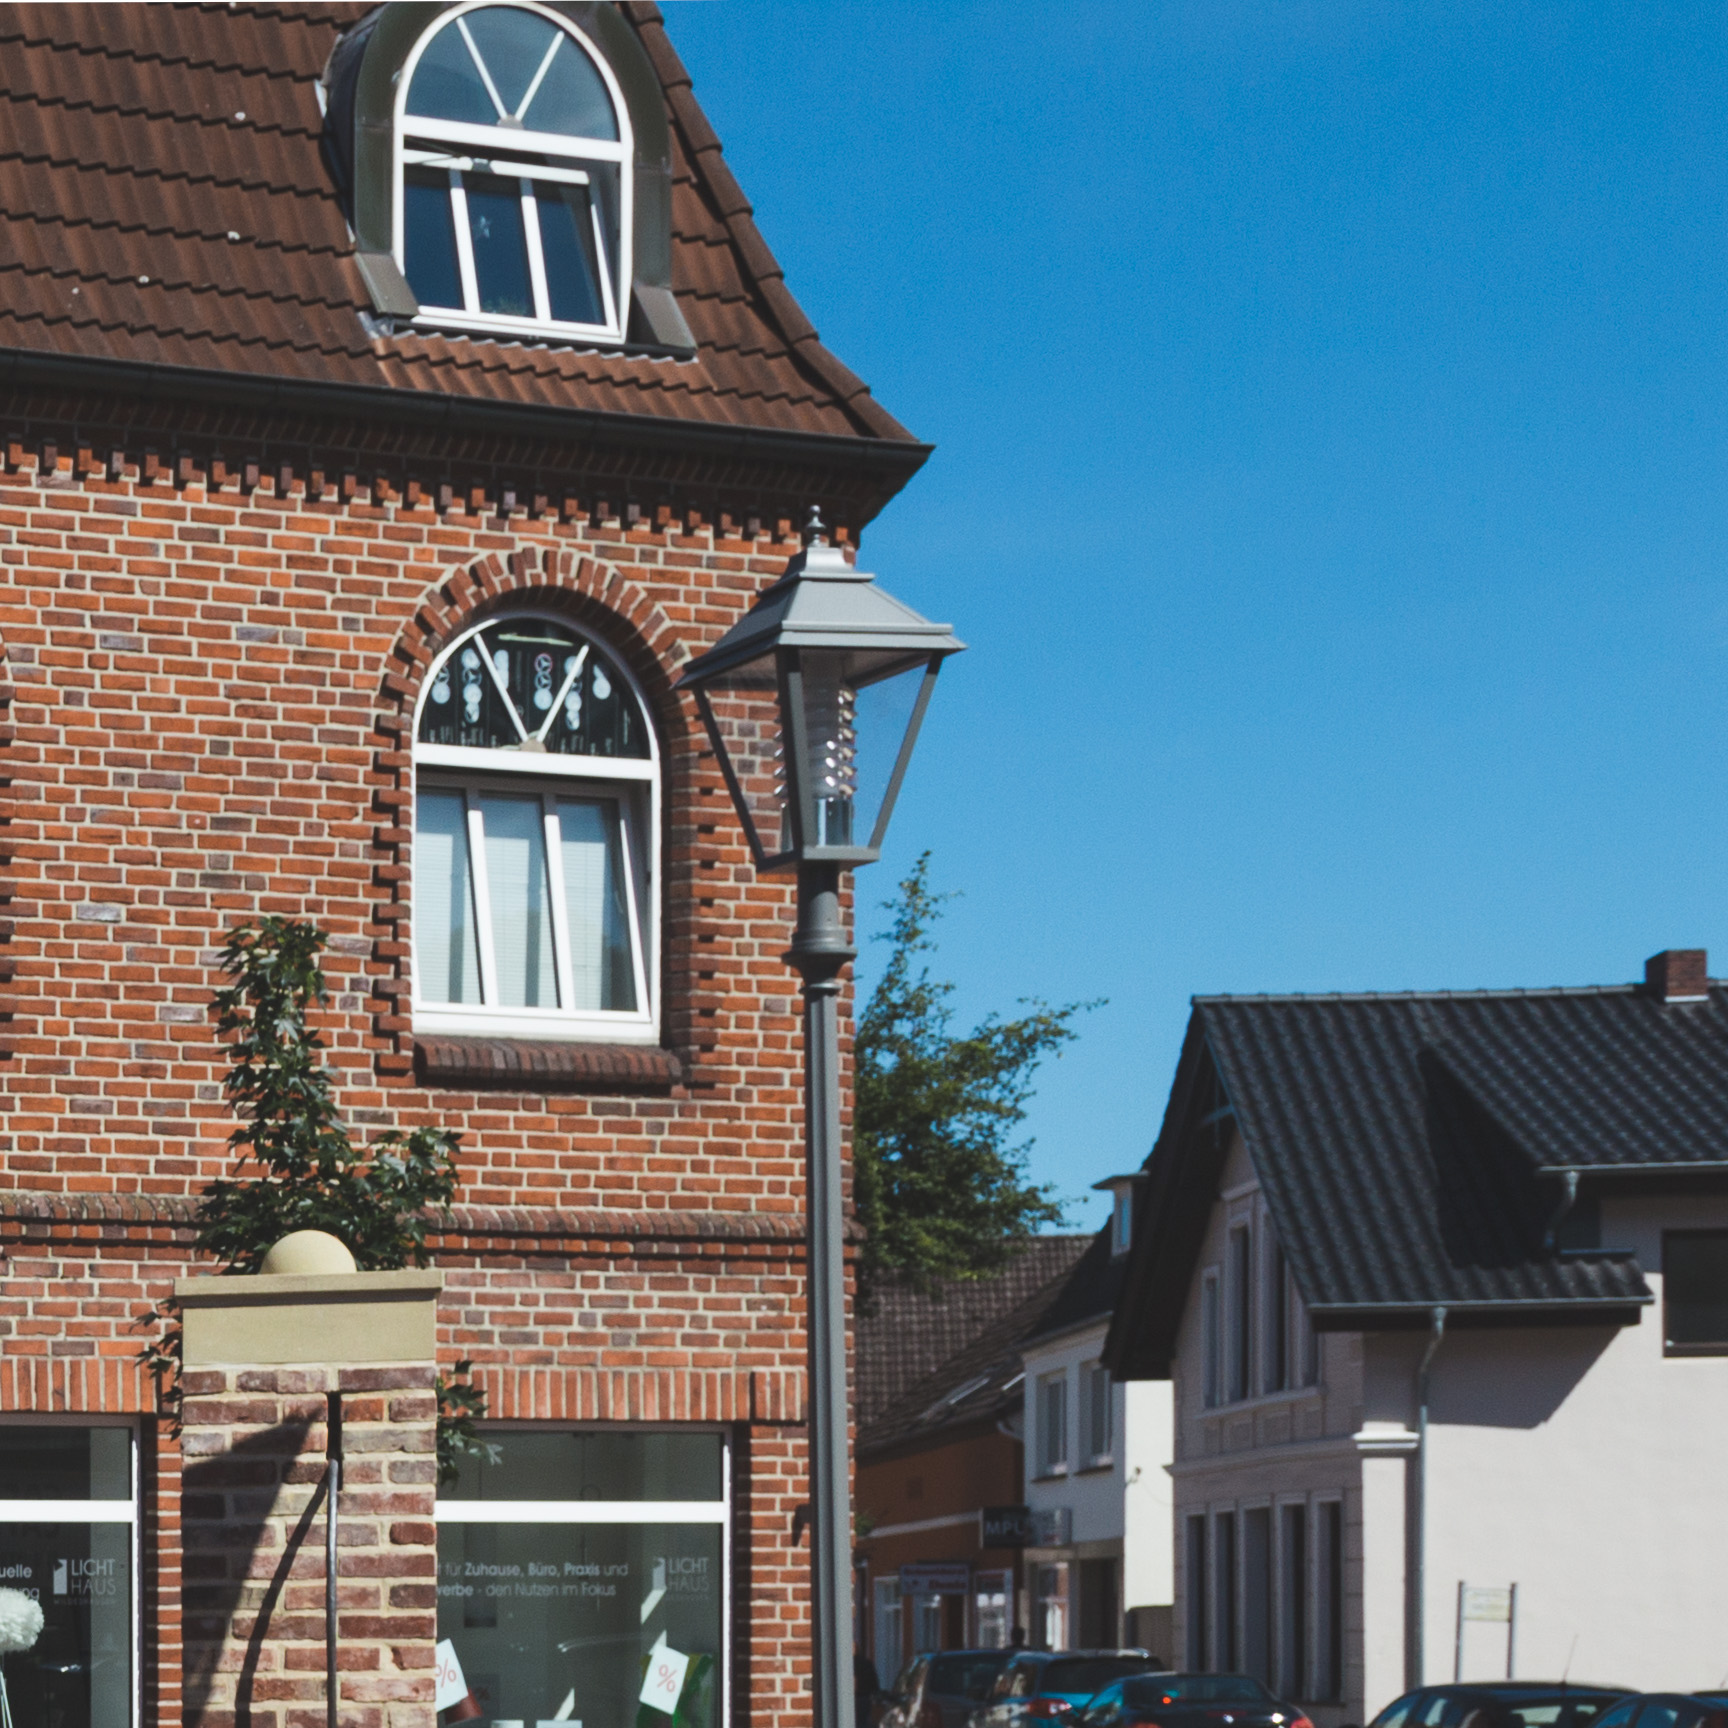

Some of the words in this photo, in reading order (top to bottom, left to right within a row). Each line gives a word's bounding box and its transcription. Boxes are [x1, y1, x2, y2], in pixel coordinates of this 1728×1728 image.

[71, 1559, 116, 1576] LICHT
[464, 1562, 524, 1577] Zuhause,
[527, 1562, 560, 1577] Büro,
[564, 1562, 601, 1576] Praxis
[603, 1562, 629, 1576] und
[668, 1557, 710, 1574] LICHT
[71, 1578, 117, 1596] HAUS
[485, 1583, 512, 1596] den
[515, 1583, 559, 1596] Nutzen
[581, 1582, 617, 1596] Fokus
[658, 1664, 678, 1693] %
